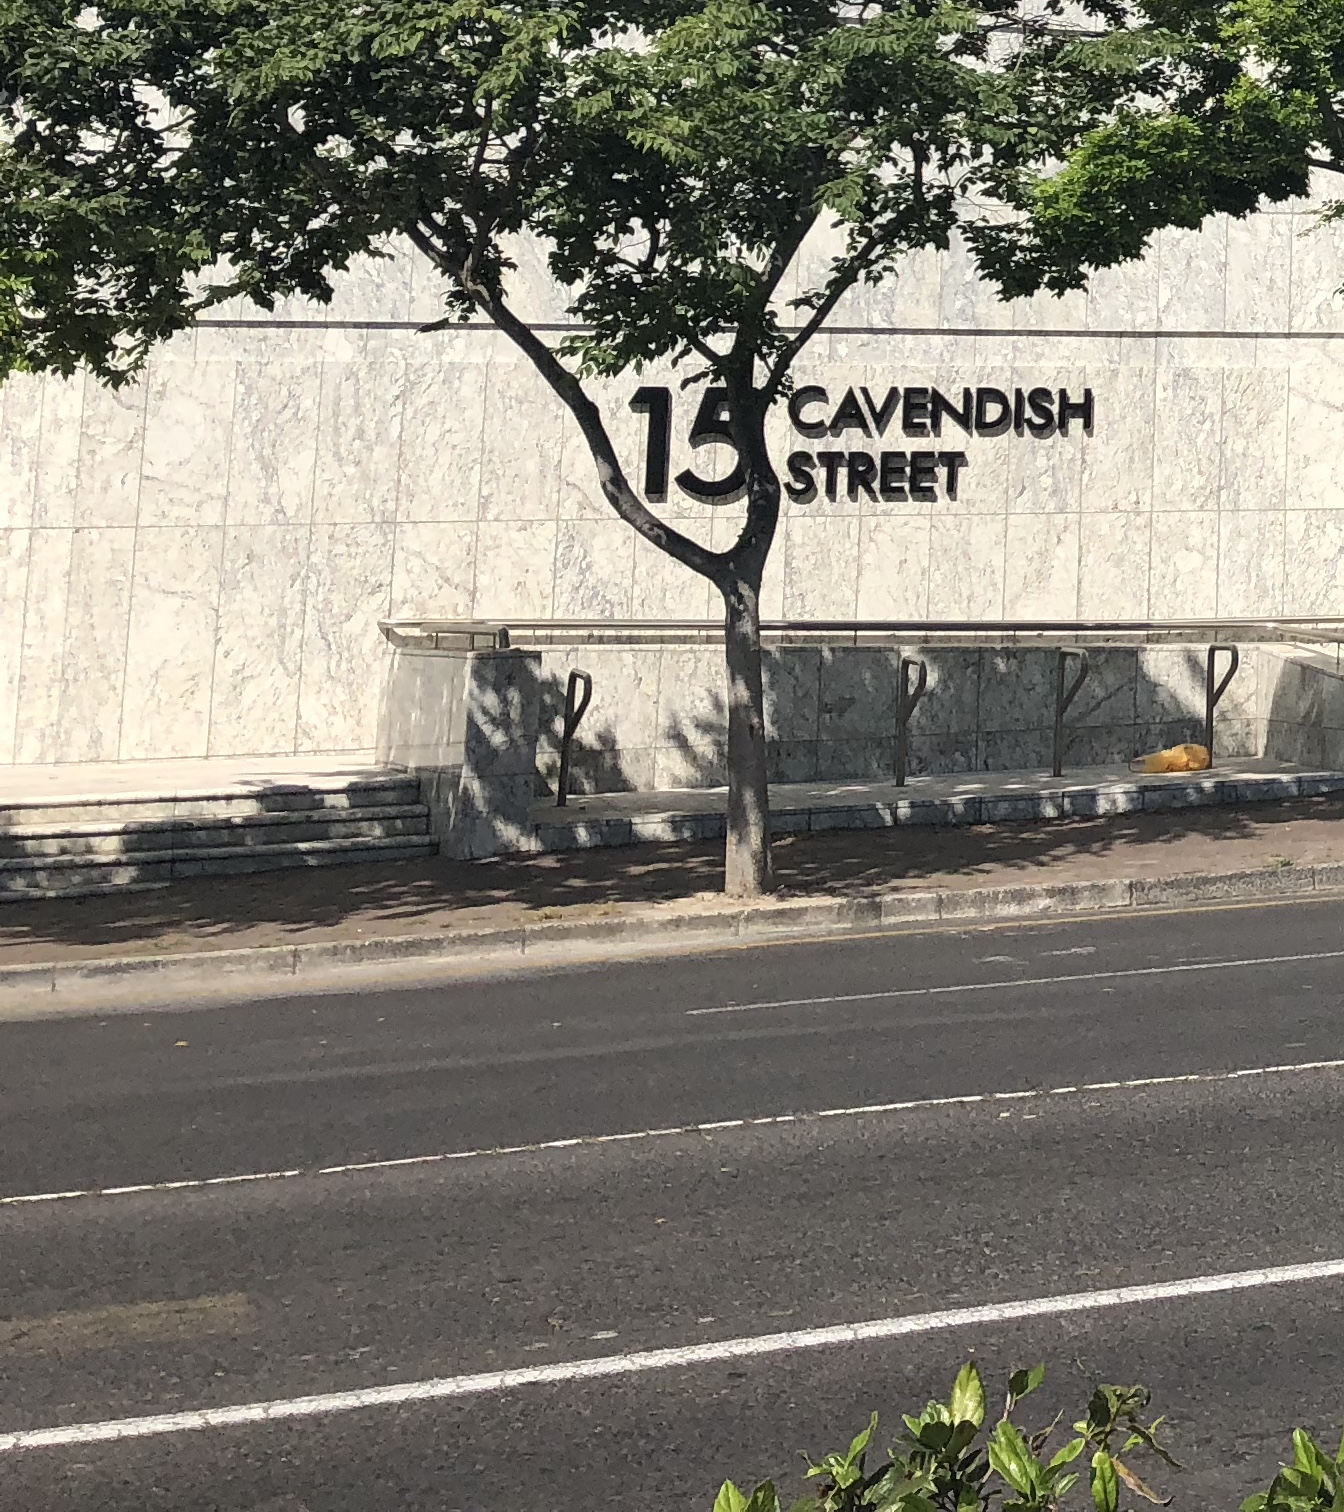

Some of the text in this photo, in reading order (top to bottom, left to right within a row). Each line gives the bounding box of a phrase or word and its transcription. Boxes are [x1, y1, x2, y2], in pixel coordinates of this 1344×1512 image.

[787, 385, 1093, 436] CAVENDISH
[629, 387, 752, 501] 15
[782, 450, 968, 502] STREET
